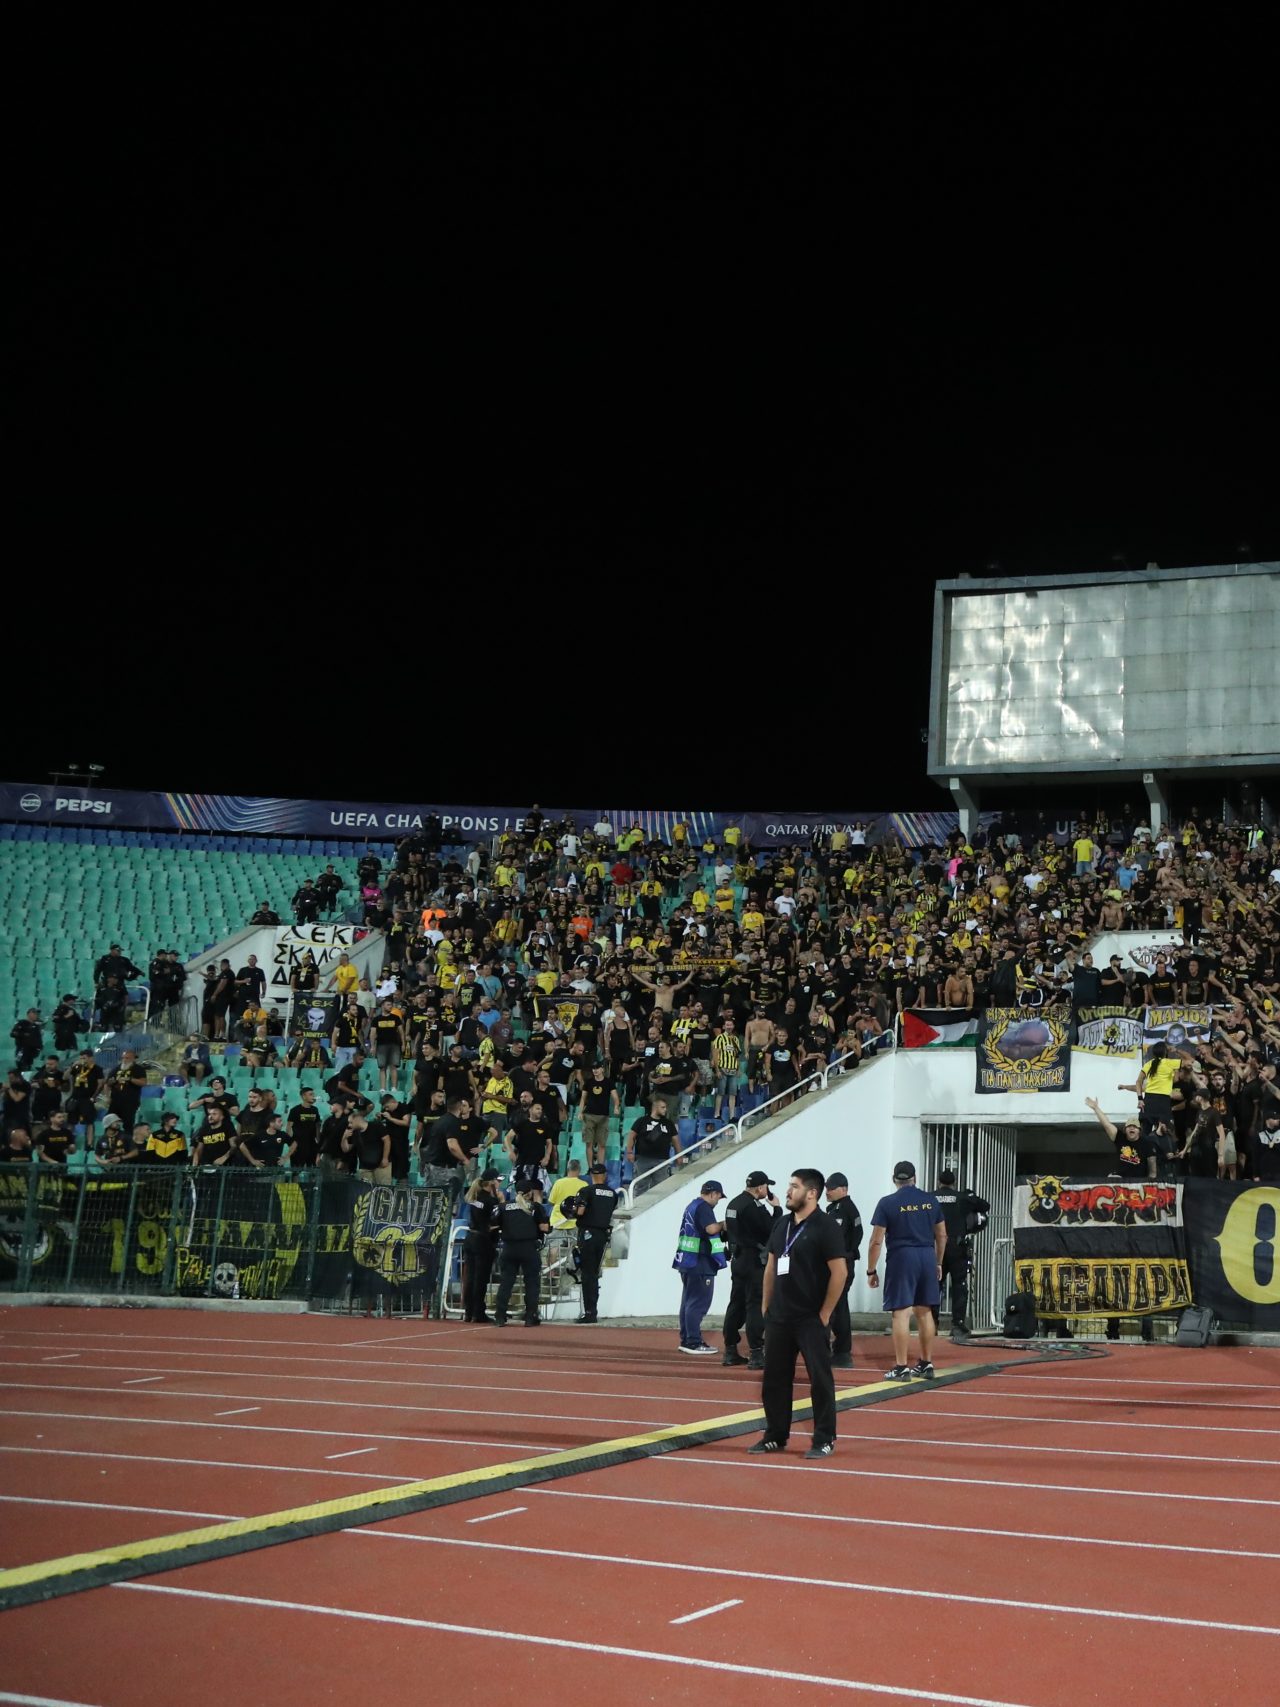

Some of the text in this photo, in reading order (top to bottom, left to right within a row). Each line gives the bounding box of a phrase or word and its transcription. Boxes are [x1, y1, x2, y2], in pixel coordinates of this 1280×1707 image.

[55, 798, 113, 814] PEPSI
[330, 811, 379, 828] UEFA
[384, 813, 499, 833] CHAPIONS
[765, 823, 809, 837] QATAR
[1077, 1006, 1127, 1023] Original
[369, 1186, 444, 1227] GATE
[921, 1202, 933, 1210] FC
